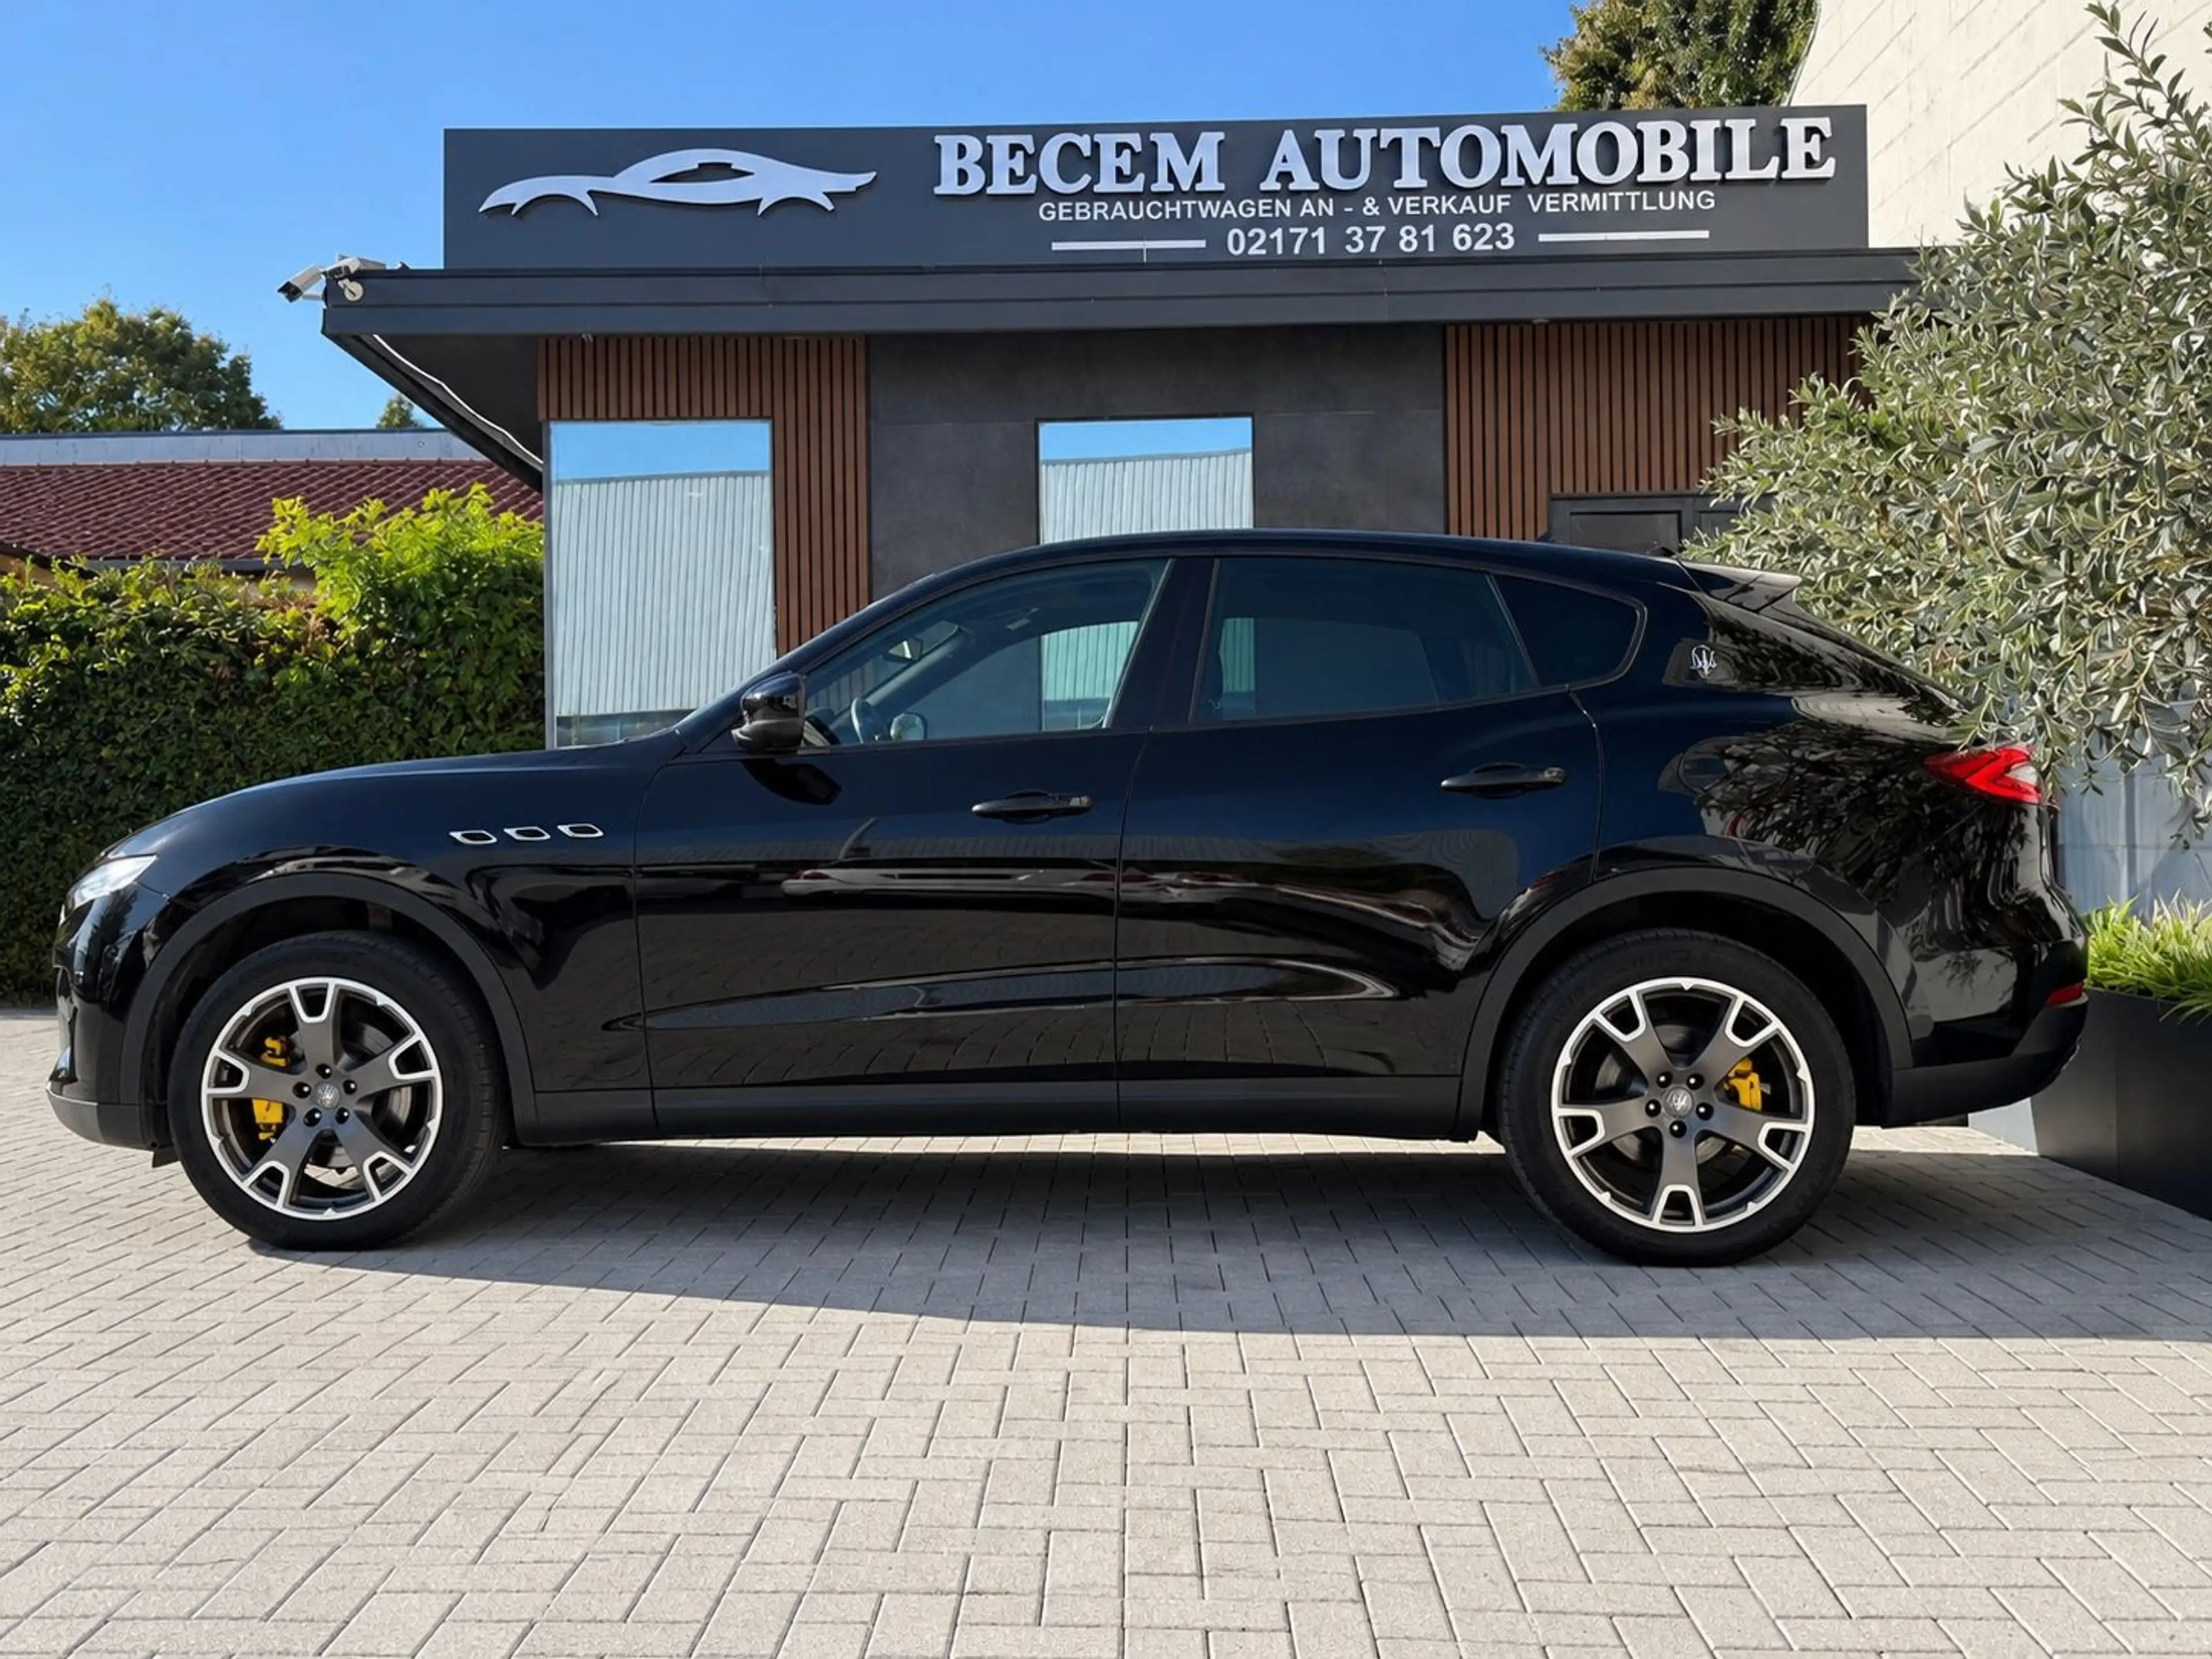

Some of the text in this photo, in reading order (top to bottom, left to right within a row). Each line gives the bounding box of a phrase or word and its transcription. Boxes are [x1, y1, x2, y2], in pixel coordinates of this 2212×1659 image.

[934, 117, 1836, 195] BECEM AUTOMOBILE
[1039, 198, 1290, 221] GEBRAUCHTWAGEN
[1300, 198, 1334, 217] AN
[1362, 196, 1380, 216] &
[1388, 194, 1512, 215] VERKAUF
[1527, 190, 1715, 213] VERMITTLUNG
[1227, 222, 1515, 256] 02171 37 81 623
